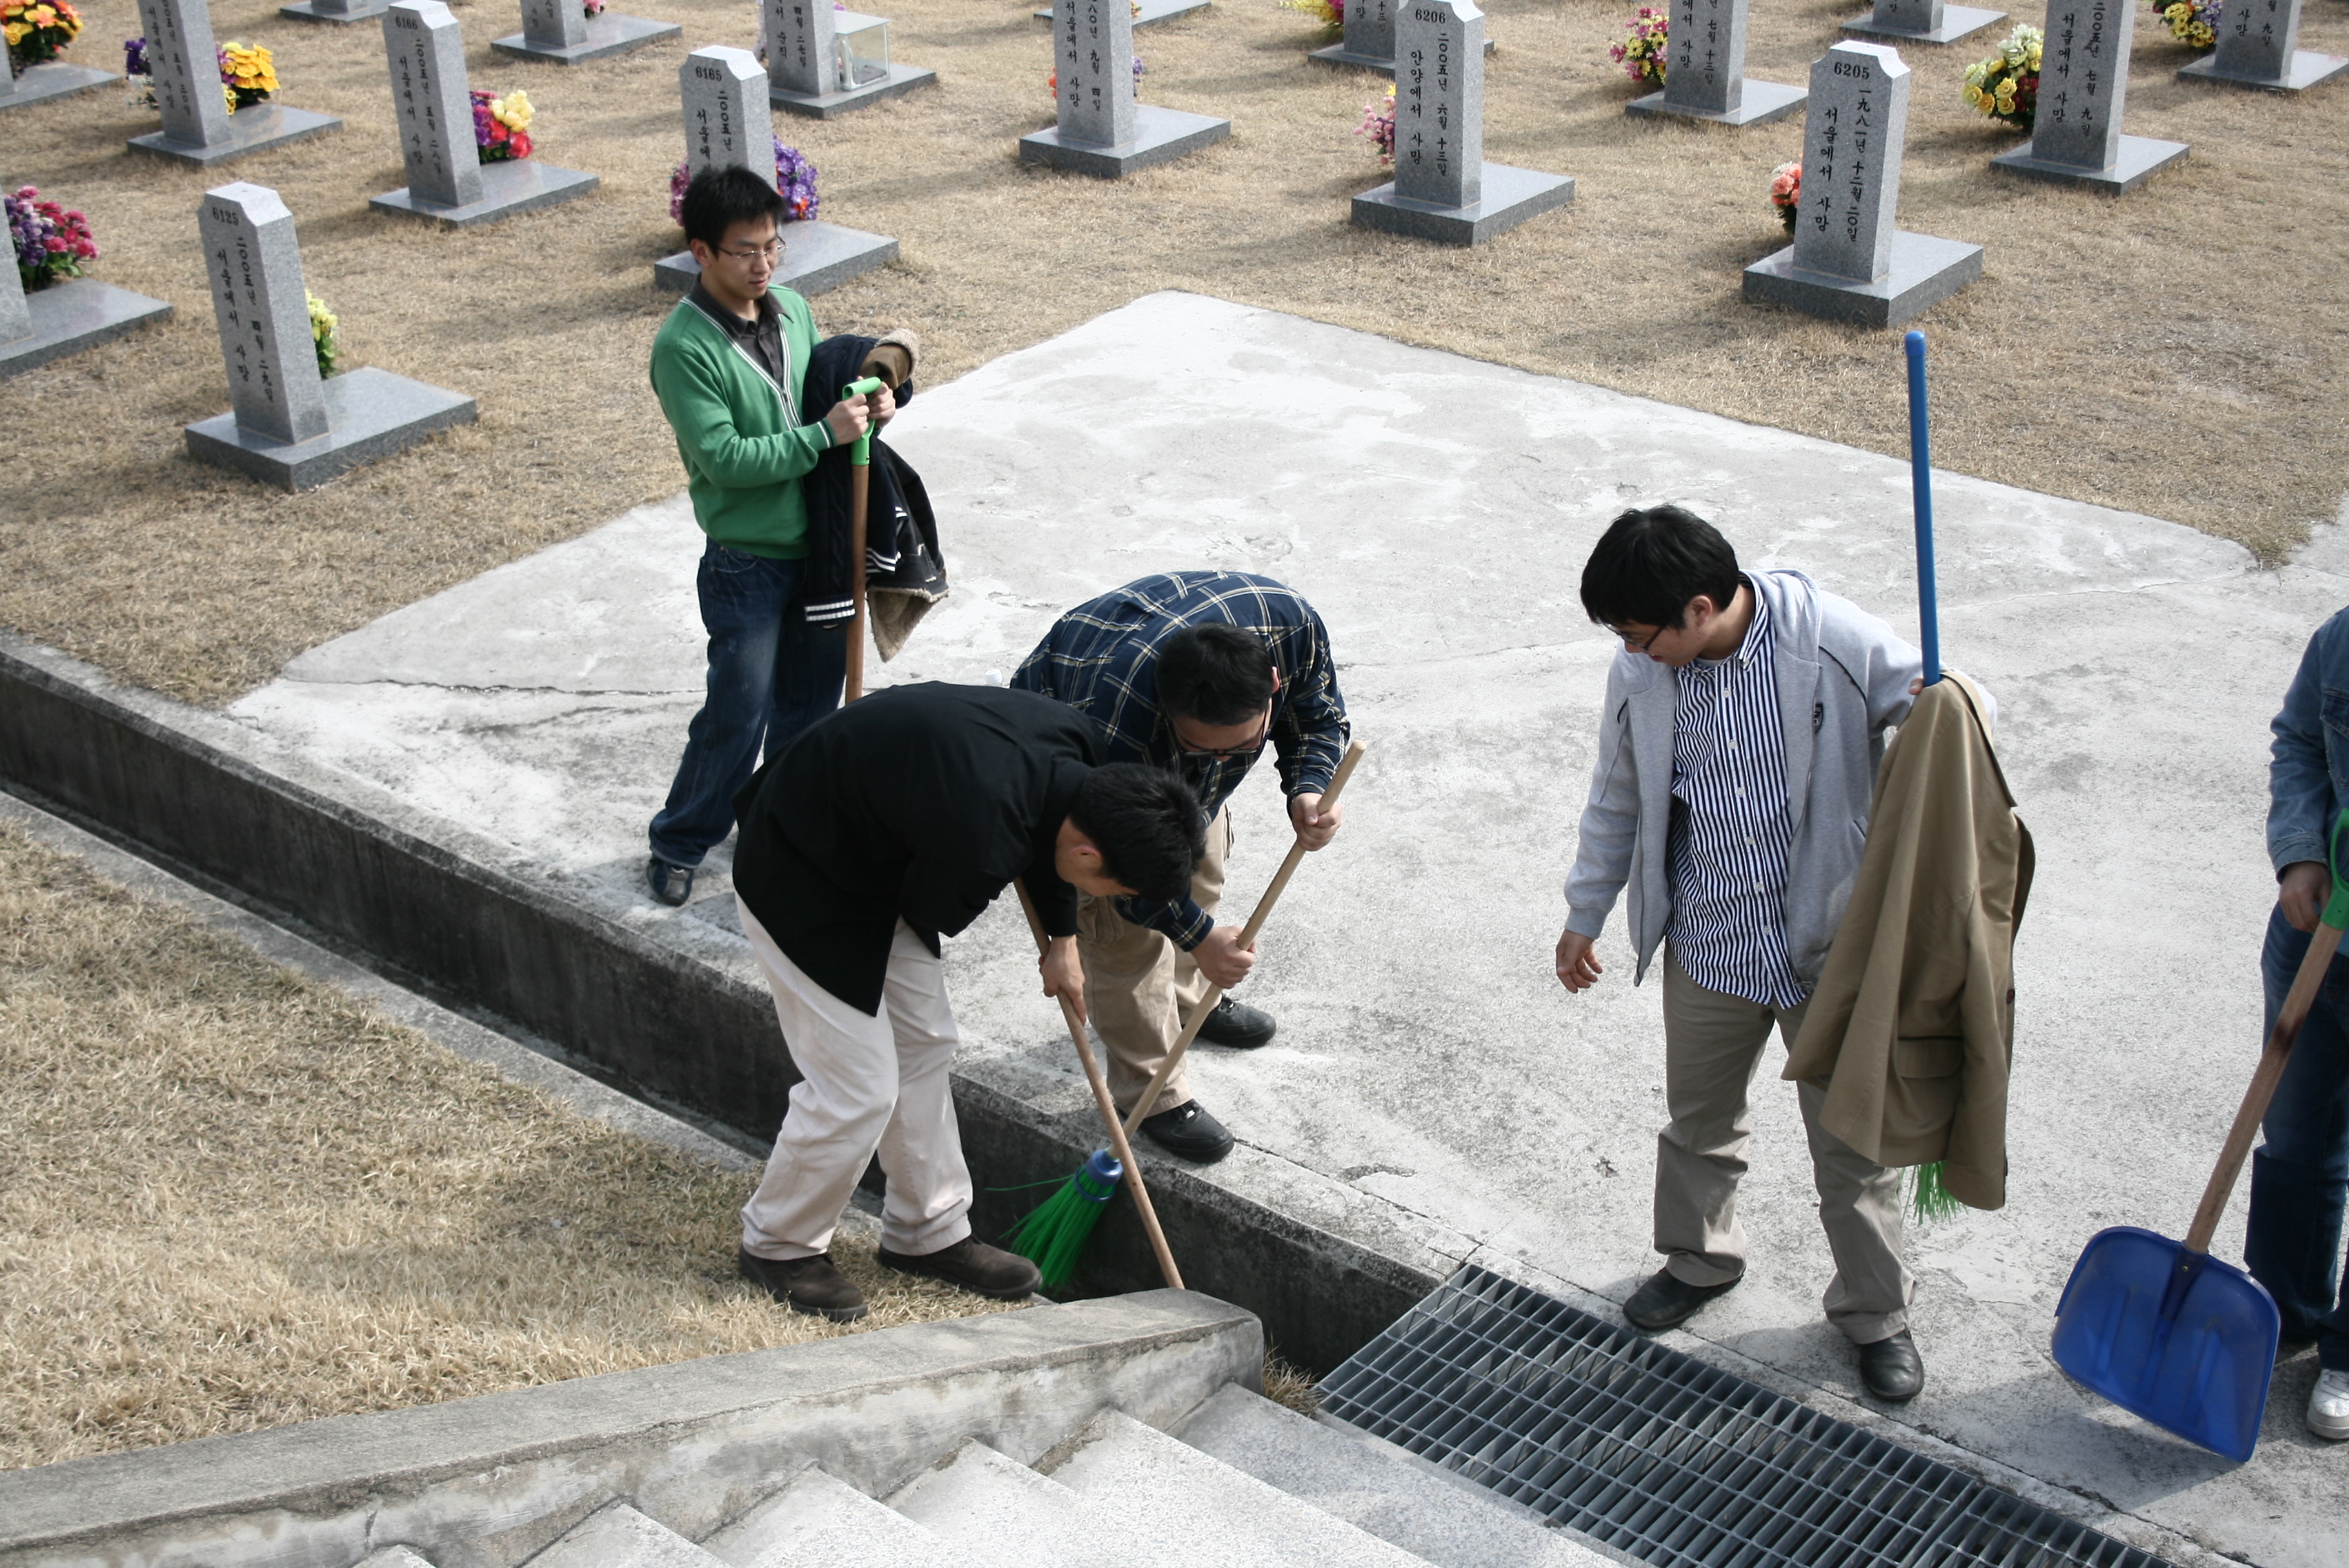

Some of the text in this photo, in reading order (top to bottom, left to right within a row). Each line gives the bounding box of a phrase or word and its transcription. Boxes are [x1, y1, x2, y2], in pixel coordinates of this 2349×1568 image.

[395, 16, 418, 30] 6166
[1416, 9, 1446, 23] 6206
[2236, 9, 2250, 36] 사망
[1066, 1, 1080, 107] 서울에서 사망
[1681, 39, 1693, 68] 사망
[2053, 13, 2075, 123] 서울에서 사망
[696, 66, 722, 82] 6165
[1834, 62, 1869, 79] 6205
[399, 56, 423, 164] 서울에서 사망
[1410, 51, 1423, 165] 안양에서 사망
[1437, 104, 1448, 130] 六월
[697, 108, 710, 163] 서울에
[1816, 108, 1838, 231] 서울에서 사망
[213, 207, 239, 226] 6125
[217, 249, 249, 382] 서울에서 사망
